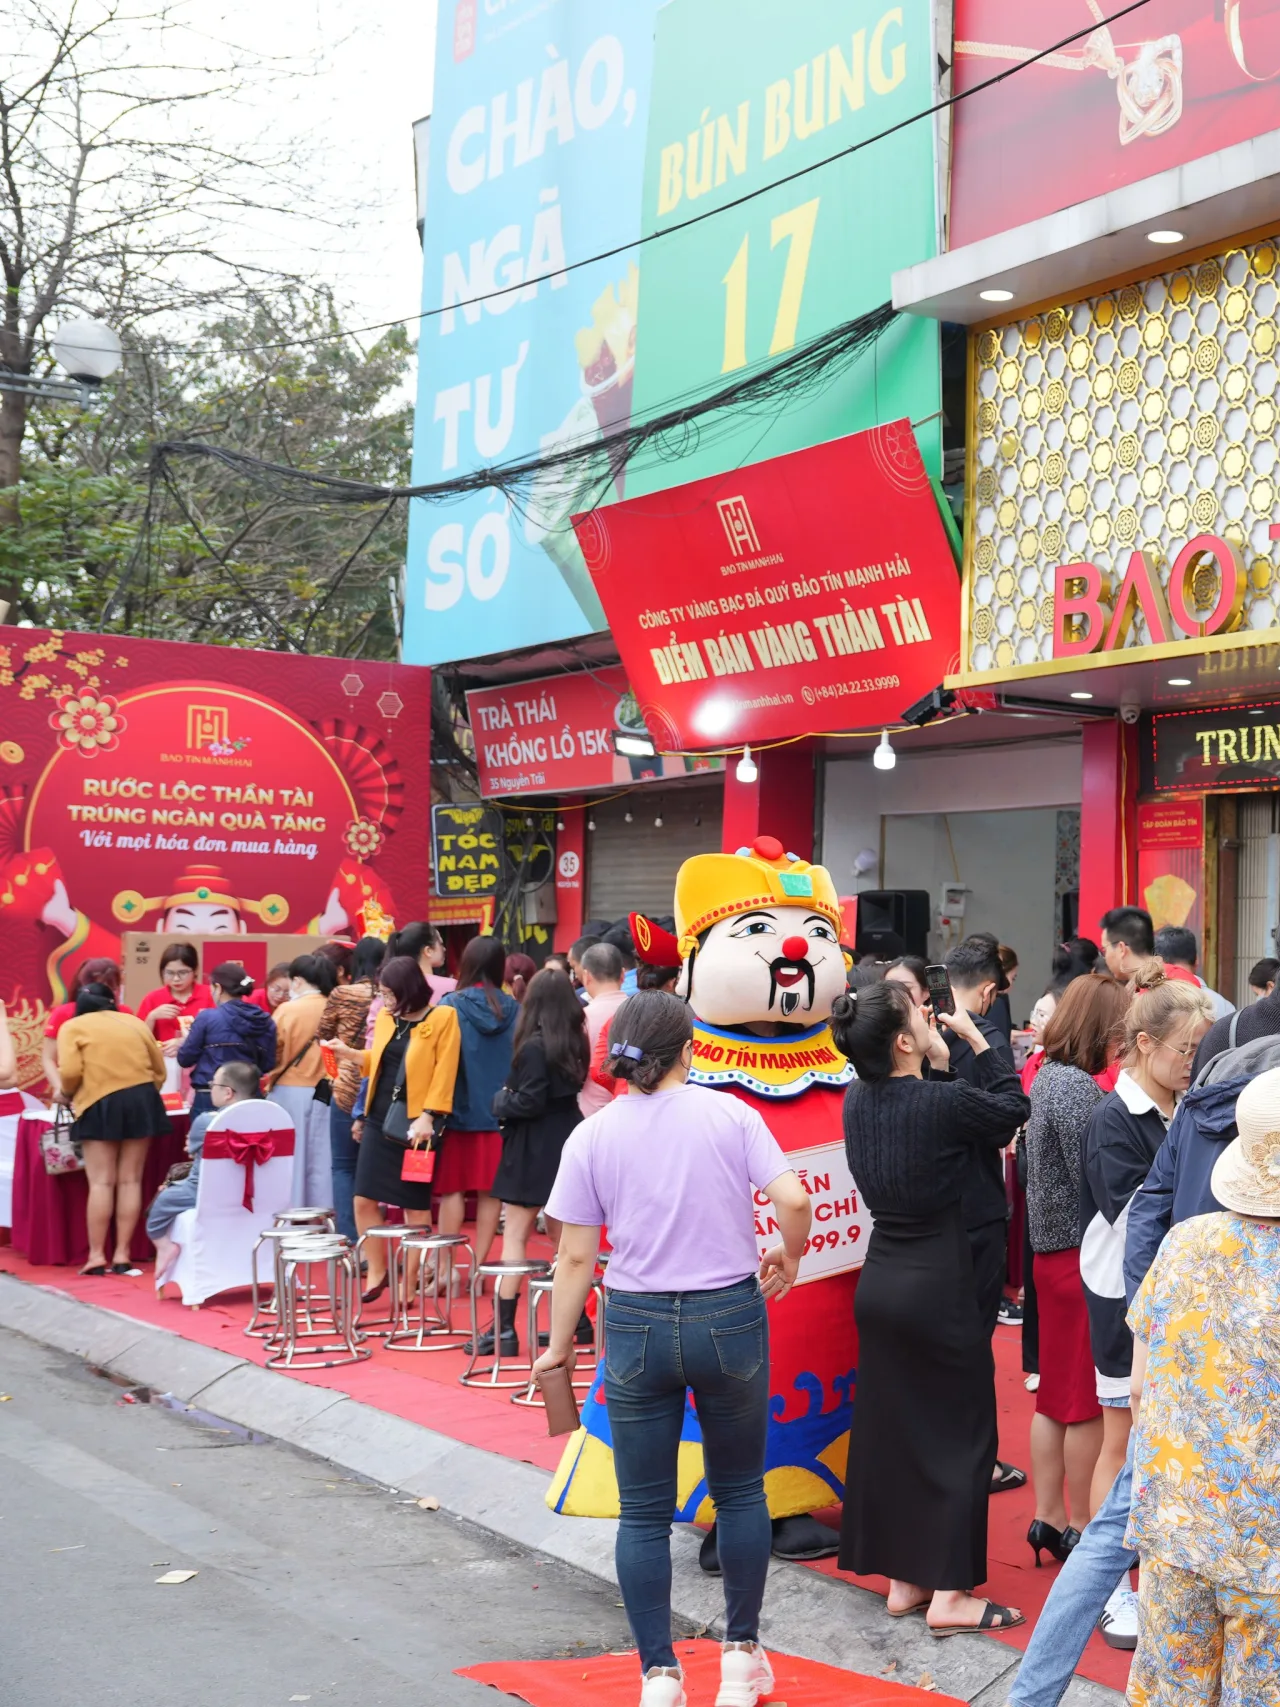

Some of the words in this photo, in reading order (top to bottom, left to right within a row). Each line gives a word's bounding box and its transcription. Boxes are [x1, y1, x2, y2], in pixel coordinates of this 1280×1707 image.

[446, 43, 637, 194] CHÀO,
[657, 100, 750, 217] BÚN
[763, 7, 907, 161] BUNG
[440, 185, 568, 335] NGÃ
[721, 196, 821, 375] 17
[433, 340, 530, 471] TƯ
[638, 608, 671, 629] CÔNG
[669, 606, 686, 623] TY
[685, 599, 719, 620] VÀNG
[720, 594, 745, 615] BẠC
[745, 586, 763, 608] ĐÁ
[764, 580, 790, 604] QUÝ
[792, 574, 820, 598] BẢO
[820, 570, 844, 592] TÍN
[845, 564, 885, 588] MẠNH
[886, 552, 912, 579] HẢI
[650, 631, 708, 685] ĐIỂM
[703, 629, 754, 677] BÁN
[748, 621, 819, 669] VÀNG
[813, 598, 885, 657] THẦN
[881, 594, 932, 646] TÀI
[478, 698, 514, 731] TRÀ
[514, 691, 558, 726] THÁI
[484, 731, 547, 768] KHỔNG
[577, 728, 610, 757] 15K
[83, 777, 153, 799] RƯỚC
[159, 780, 206, 804] LỘC
[211, 783, 274, 805] THẦN
[279, 786, 314, 807] TÀI
[490, 778, 499, 789] 35
[67, 803, 146, 824] TRÚNG
[152, 808, 214, 828] NGÀN
[219, 810, 267, 832] QUÀ
[270, 812, 326, 834] TẶNG
[79, 829, 113, 848] Với
[117, 833, 151, 851] mọi
[155, 833, 190, 850] hóa
[193, 836, 228, 852] đơn
[231, 841, 271, 854] mua
[273, 839, 319, 860] hàng
[438, 828, 497, 851] TÓC
[438, 854, 499, 872] NAM
[563, 856, 575, 872] 35
[446, 874, 497, 893] ĐẸP
[691, 1039, 724, 1063] BẢO
[760, 1050, 816, 1073] MẠNH
[815, 1189, 858, 1222] CHỈ
